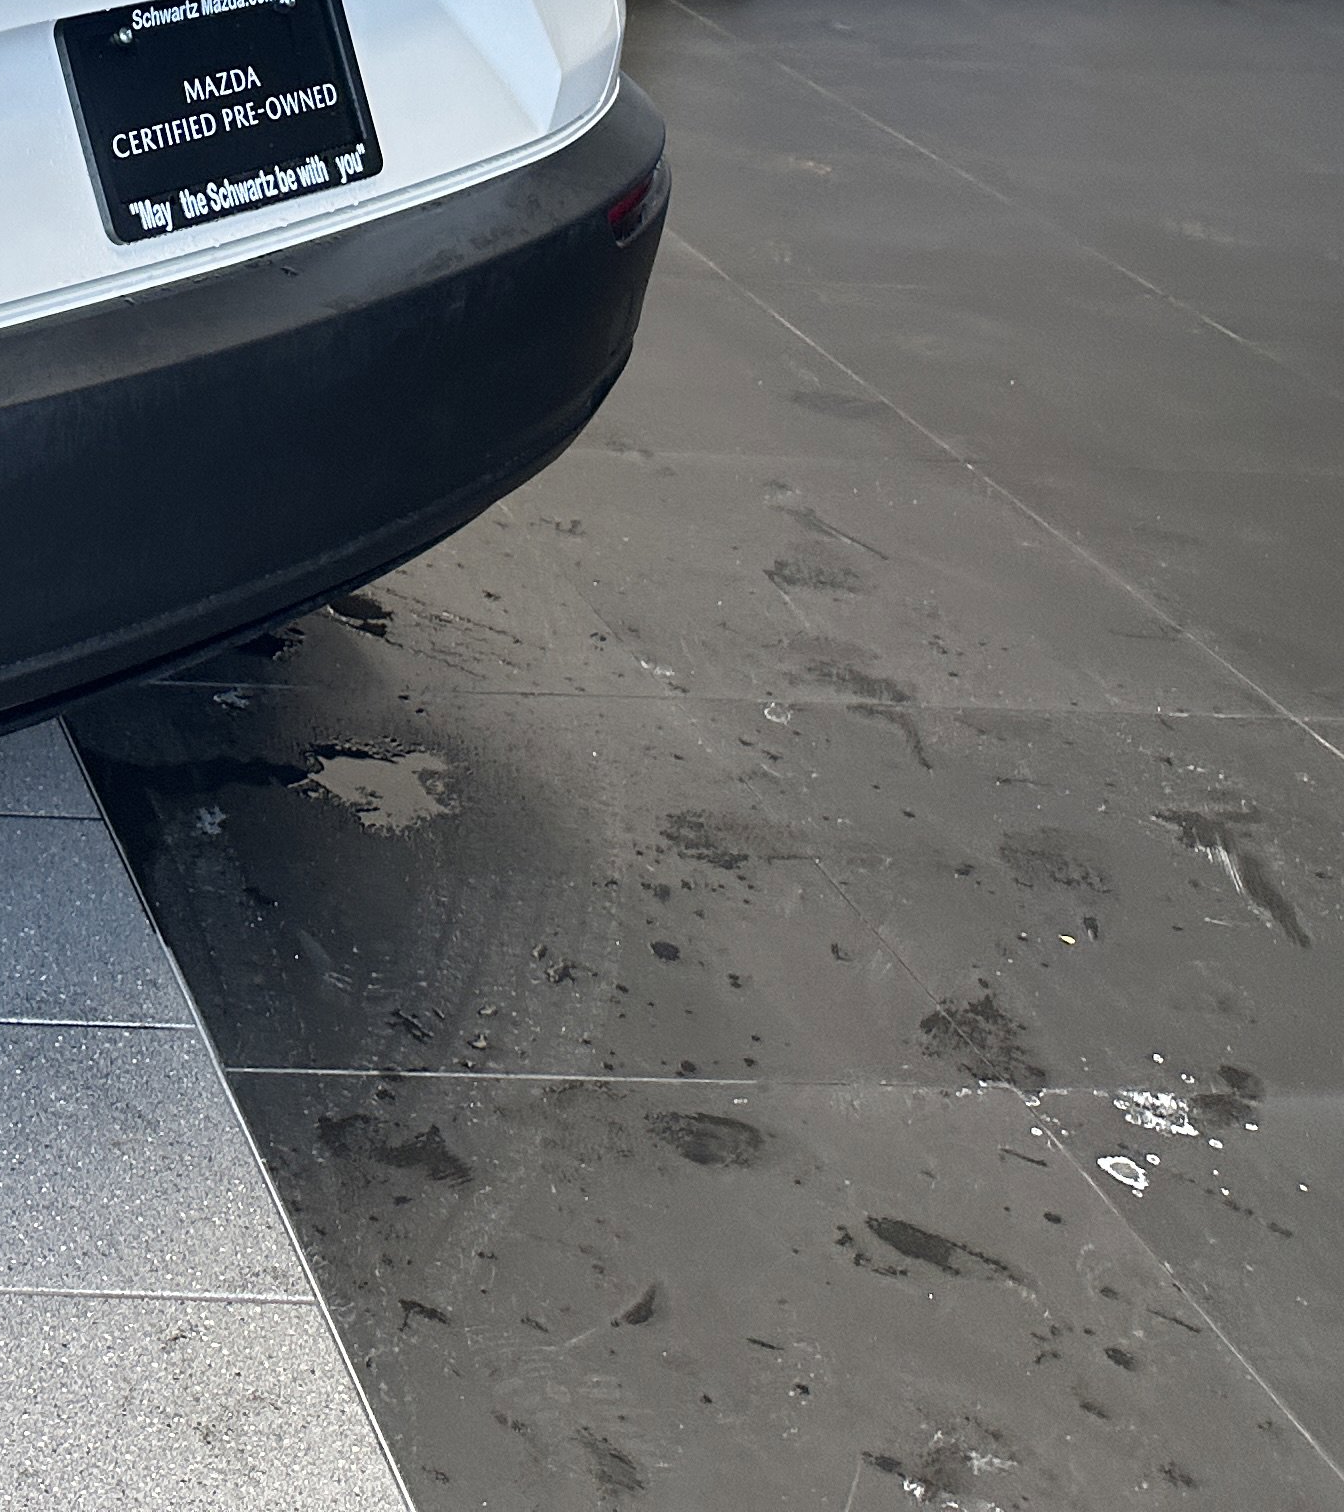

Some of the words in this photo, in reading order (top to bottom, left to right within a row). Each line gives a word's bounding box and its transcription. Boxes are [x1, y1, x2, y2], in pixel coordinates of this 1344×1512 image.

[131, 0, 199, 30] Schwartz
[183, 66, 262, 103] MAZDA
[112, 113, 217, 158] CERTIFIED
[222, 83, 338, 131] PRE-OWNED
[128, 199, 174, 232] "May
[179, 190, 208, 219] the
[206, 170, 278, 212] Schwartz
[275, 165, 297, 191] be
[296, 154, 329, 188] with
[335, 143, 366, 185] you"
